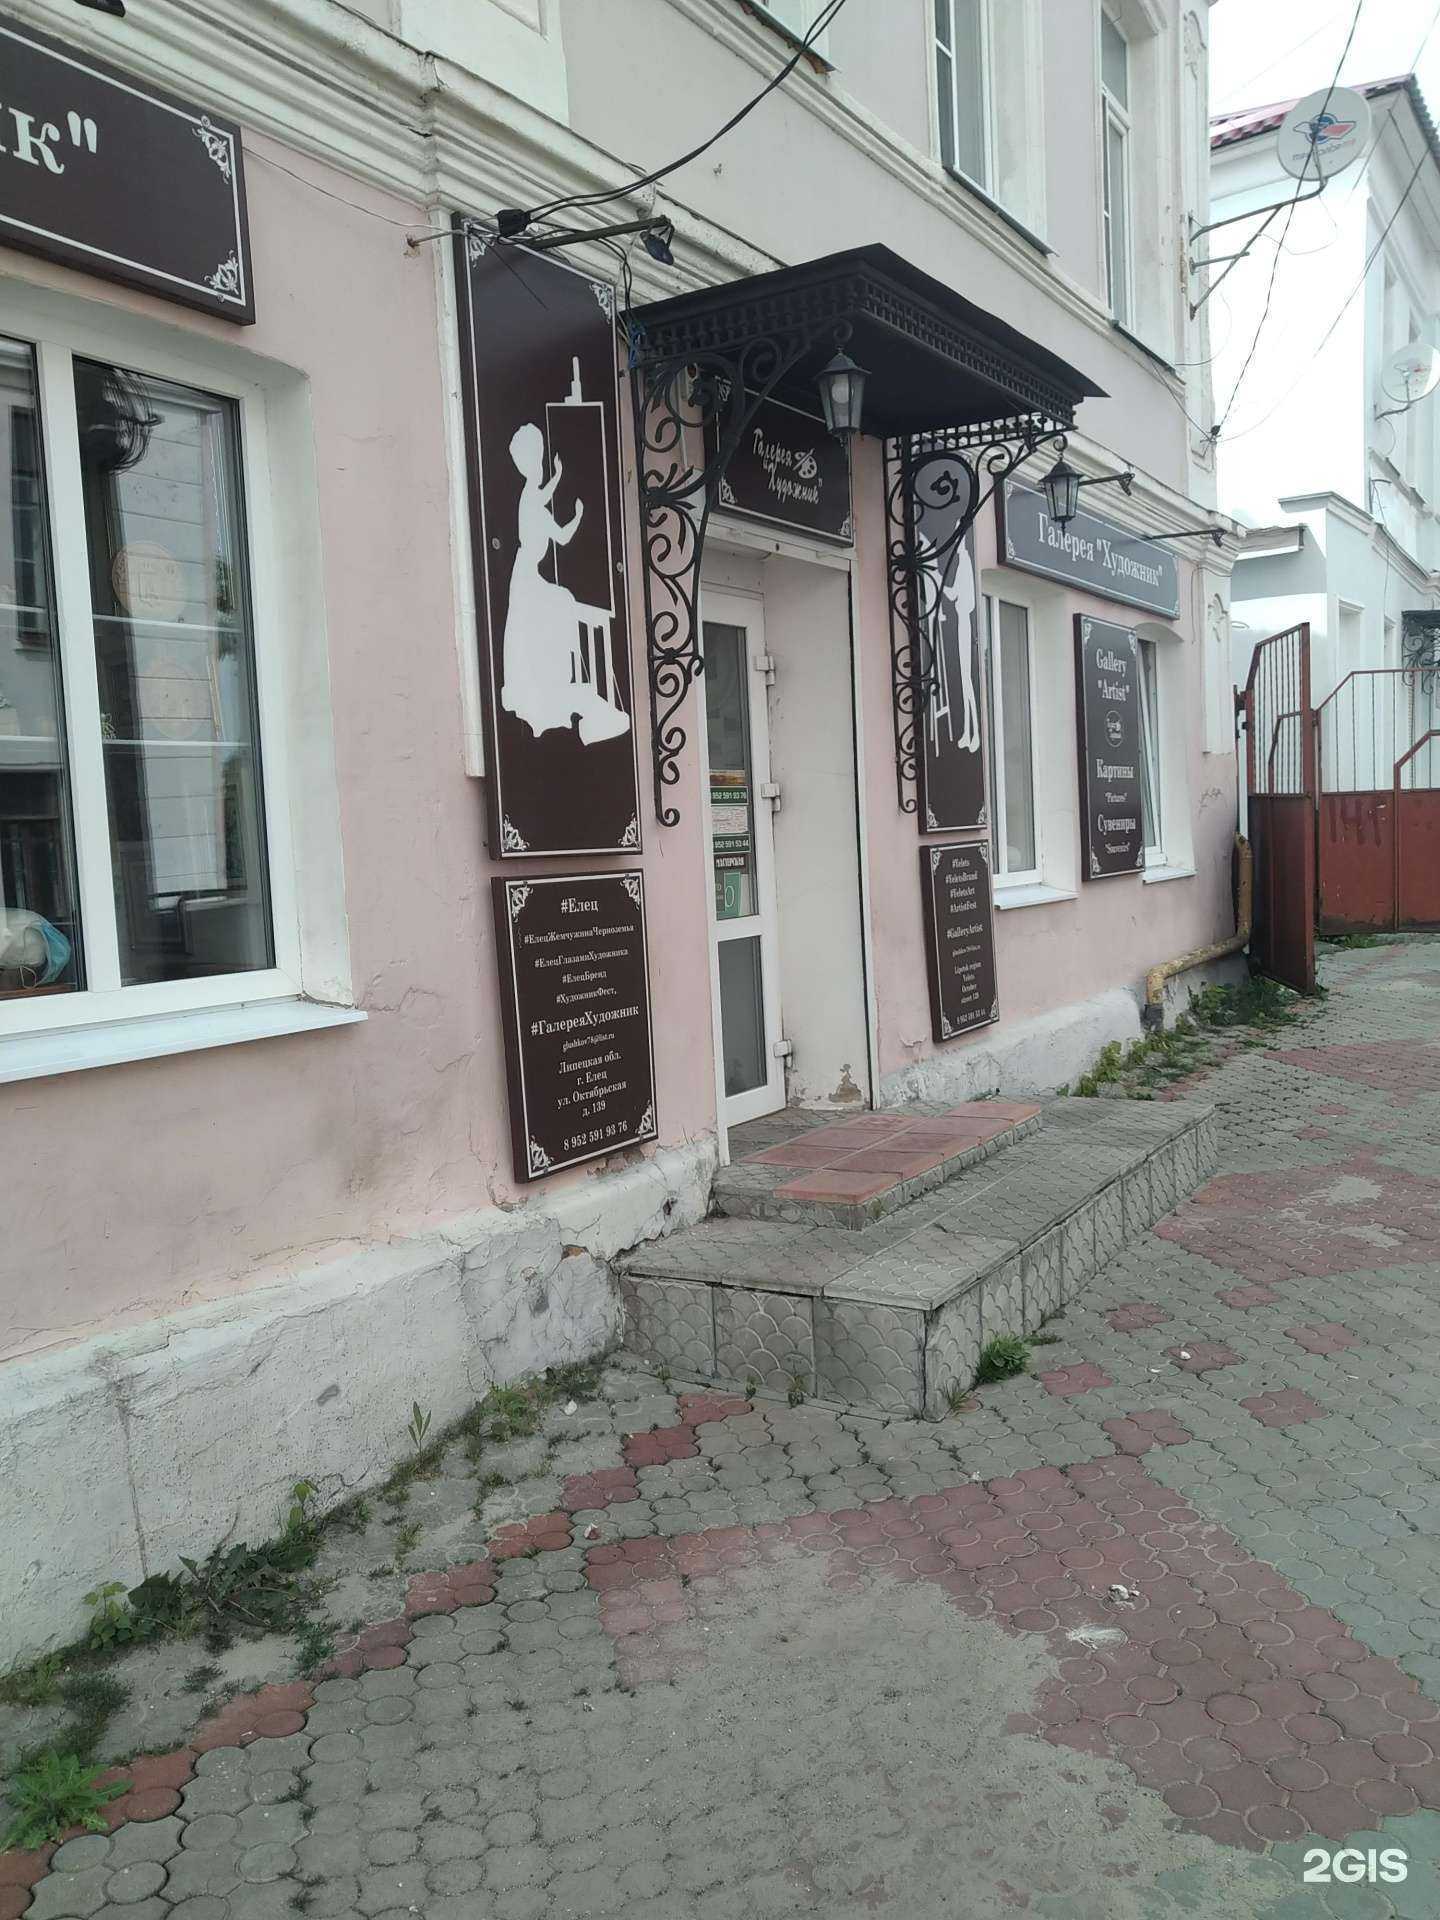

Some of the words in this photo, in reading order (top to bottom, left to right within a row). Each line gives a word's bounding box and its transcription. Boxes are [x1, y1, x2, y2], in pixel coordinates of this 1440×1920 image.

[753, 428, 792, 467] Галерея
[1038, 512, 1094, 562] Галерея
[1096, 538, 1163, 587] "Художник"
[1096, 648, 1127, 678] Gallery
[1098, 679, 1130, 701] "Artist"
[1096, 759, 1134, 782] Картины
[1097, 814, 1136, 836] Сувениры
[560, 897, 600, 914] #Елец
[524, 924, 635, 944] #ЕлецЖемчужинаЧерноземья
[534, 948, 629, 968] #ЕлецГлазамиХудожника
[562, 970, 608, 984] #ЕлецБренд
[530, 1005, 640, 1036] #ГалереяХудожник
[559, 1055, 603, 1074] Липецкая
[604, 1050, 622, 1063] обл.
[577, 1076, 584, 1086] г.
[586, 1070, 608, 1084] Елец
[557, 1097, 571, 1110] ул.
[572, 1080, 627, 1103] Октябрьская
[582, 1107, 591, 1118] д.
[592, 1100, 606, 1114] 139
[563, 1139, 569, 1151] 8
[571, 1133, 587, 1149] 952
[589, 1129, 603, 1143] 591
[606, 1124, 616, 1137] 93
[618, 1120, 628, 1133] 76
